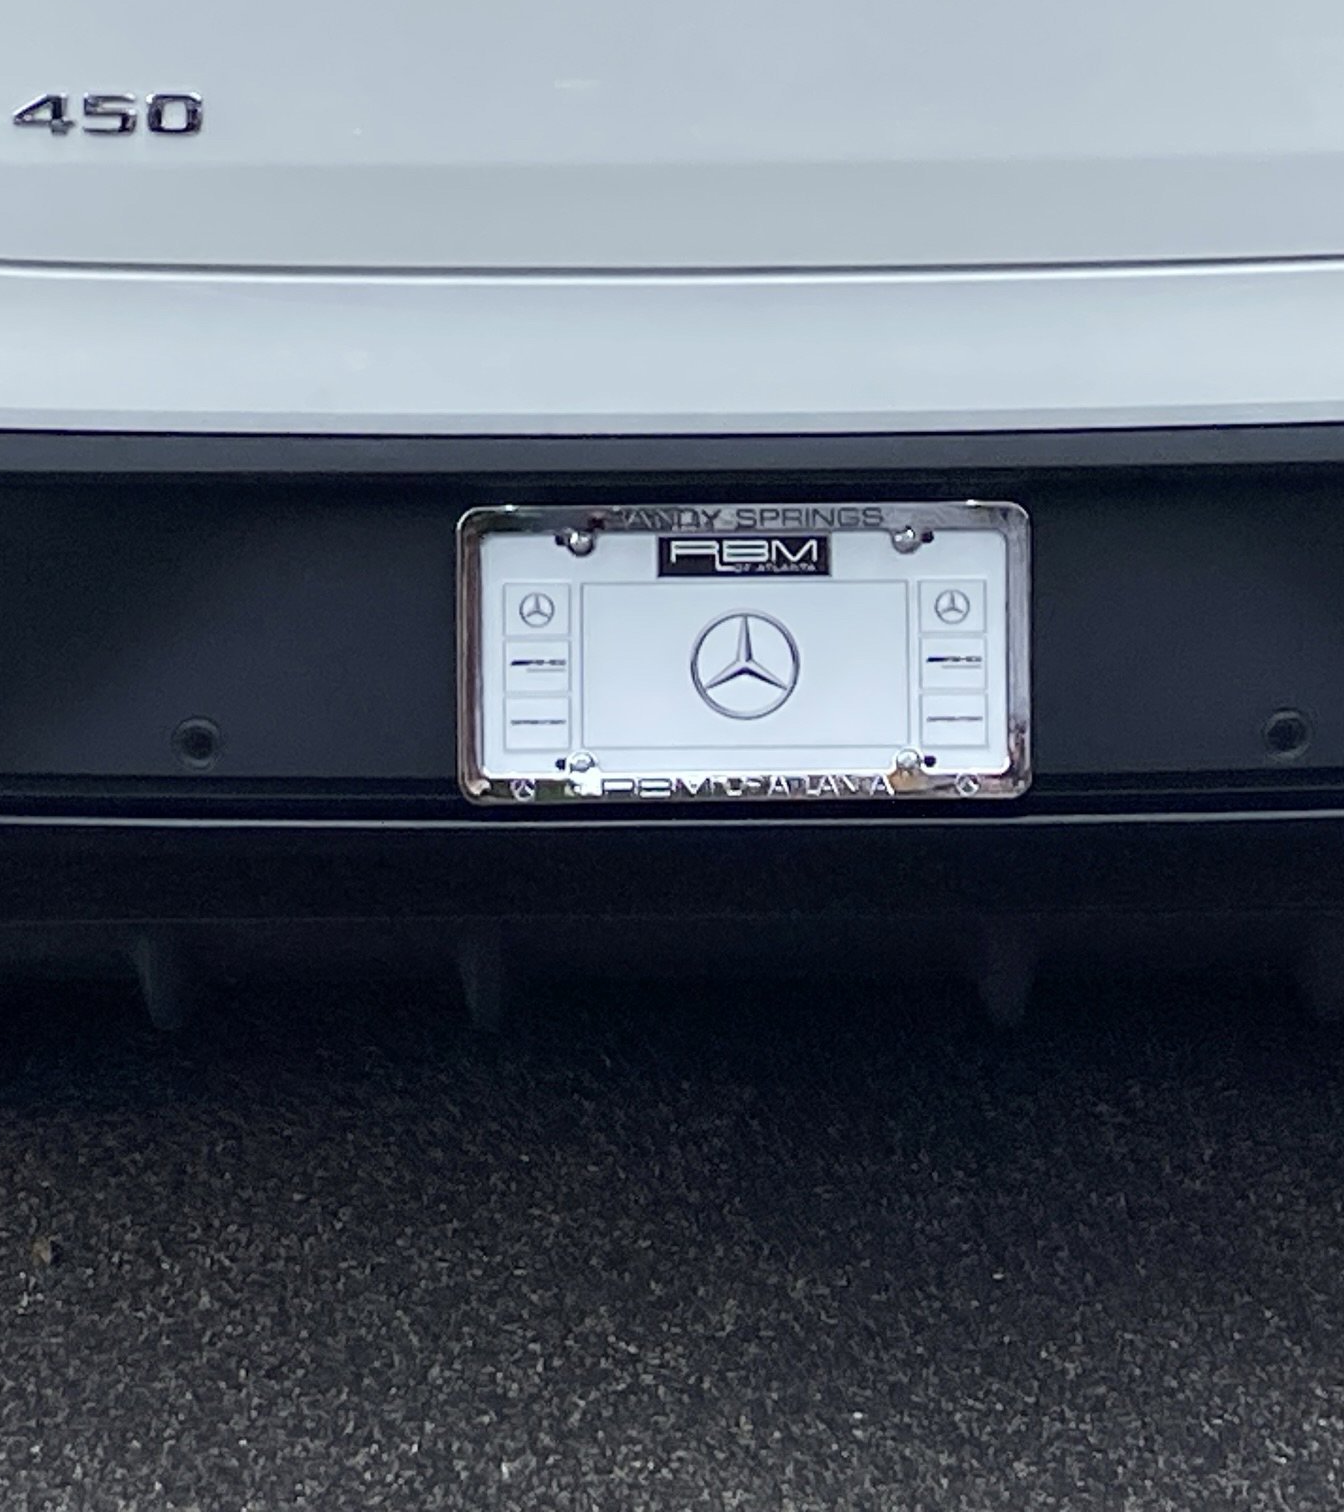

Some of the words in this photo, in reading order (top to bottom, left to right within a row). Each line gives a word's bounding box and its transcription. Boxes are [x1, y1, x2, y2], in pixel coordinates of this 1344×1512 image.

[12, 92, 204, 136] 450
[604, 508, 723, 530] ANDY
[736, 506, 885, 528] SPRINGS
[670, 539, 818, 572] RBM
